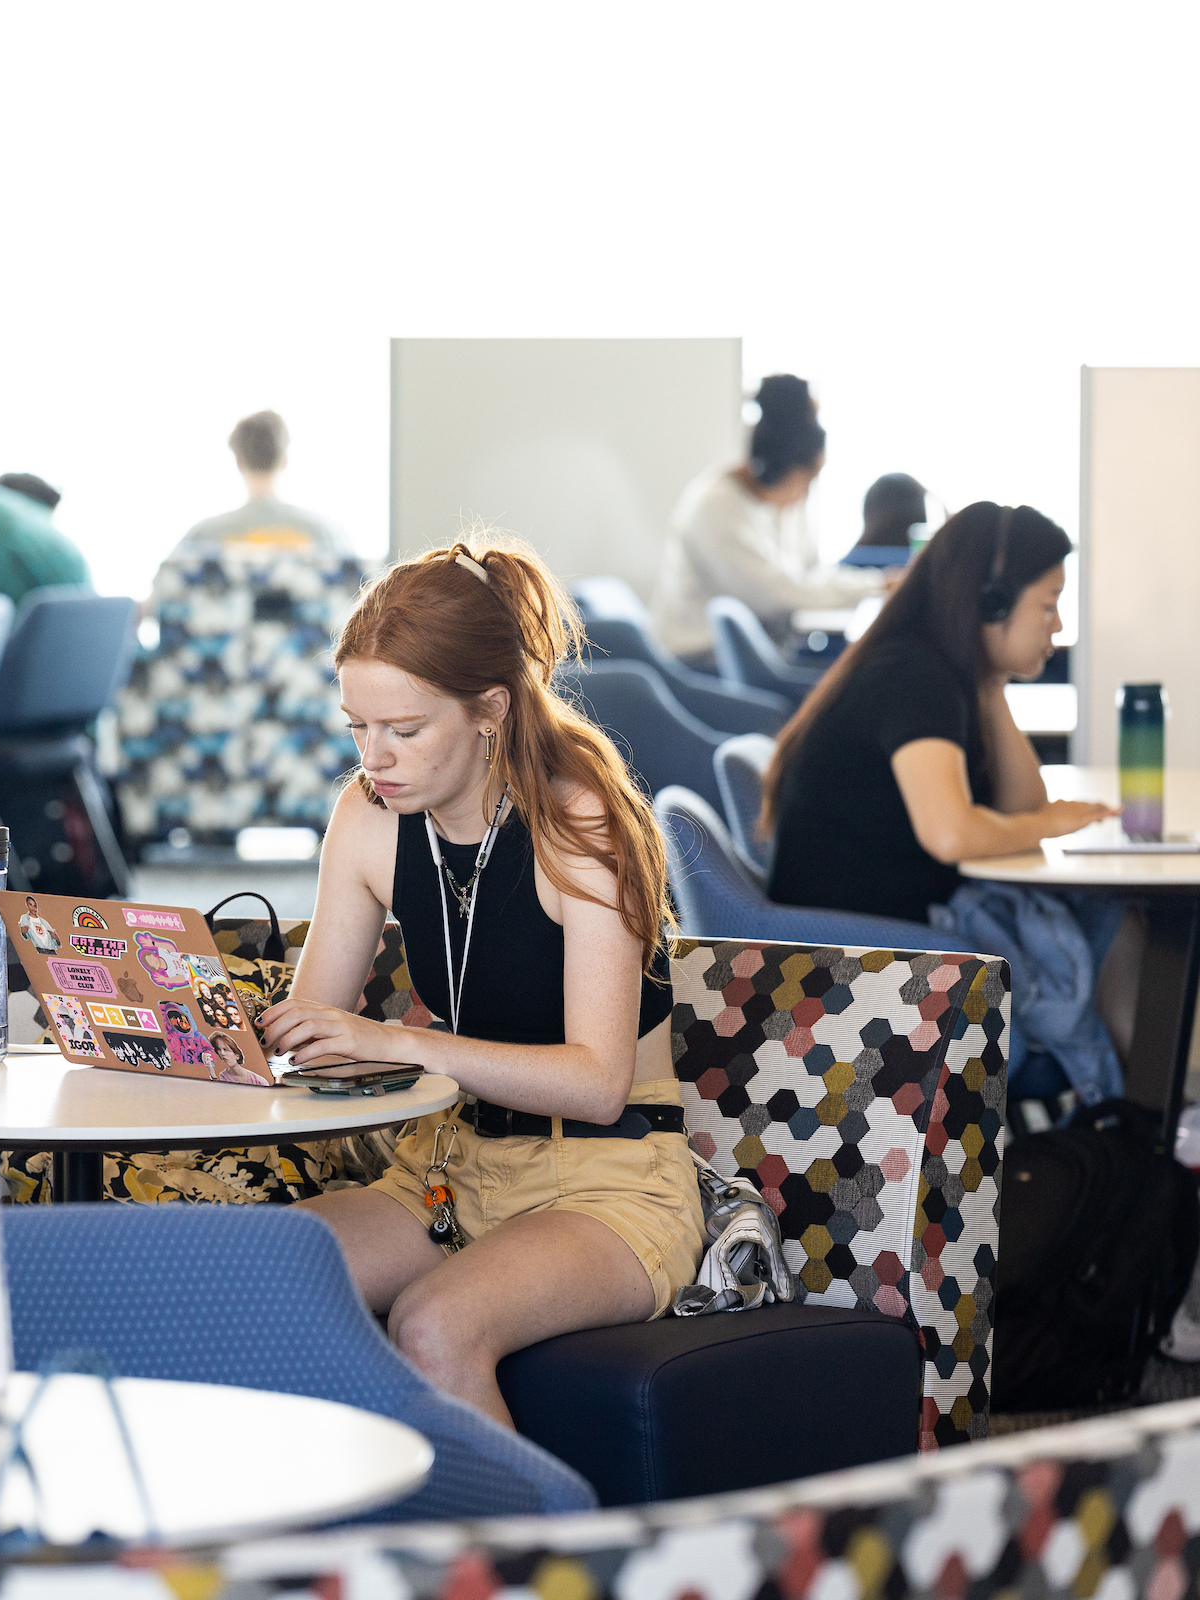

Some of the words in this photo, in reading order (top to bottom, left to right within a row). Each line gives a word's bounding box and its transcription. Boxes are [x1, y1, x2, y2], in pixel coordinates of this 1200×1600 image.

[72, 937, 95, 947] EAT
[102, 940, 125, 950] THE
[88, 946, 119, 957] RICH
[67, 967, 91, 975] LONELY
[68, 1039, 97, 1051] IGOR
[438, 1221, 444, 1229] 8
